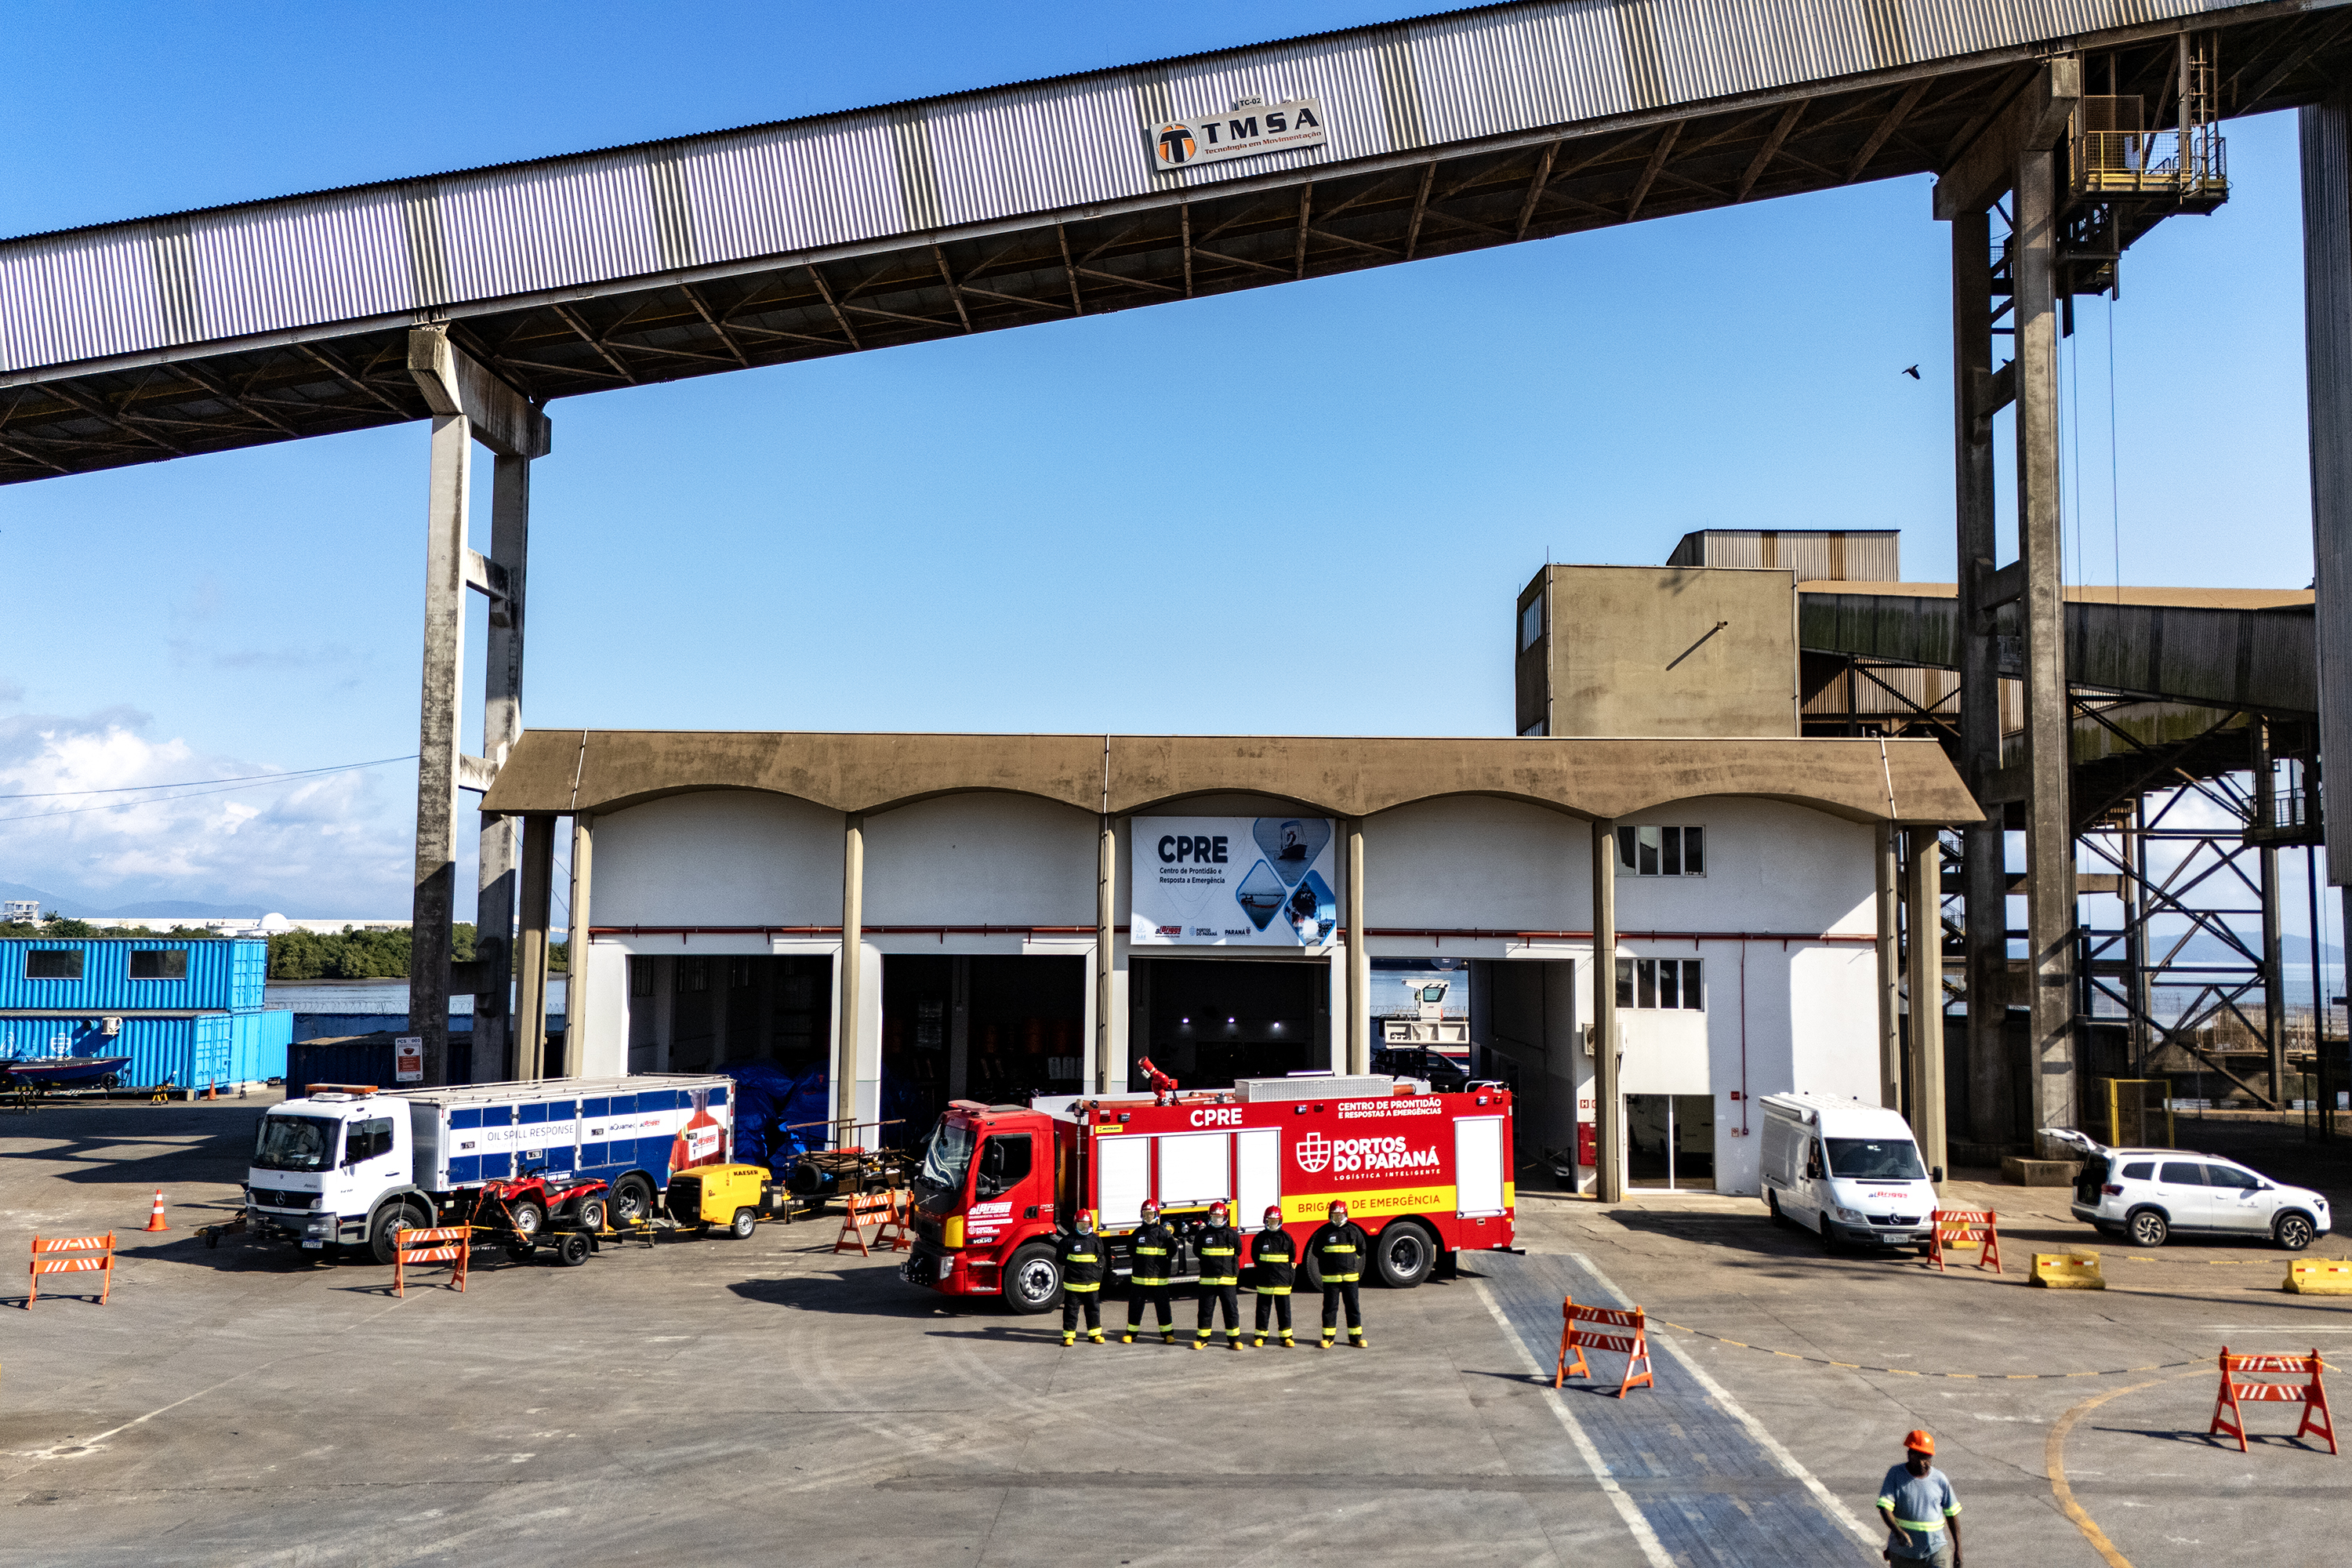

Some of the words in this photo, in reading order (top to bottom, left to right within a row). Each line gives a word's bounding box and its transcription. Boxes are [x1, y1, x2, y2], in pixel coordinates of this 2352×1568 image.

[1239, 97, 1261, 107] TC-02
[1201, 107, 1319, 144] TMSA
[1204, 143, 1247, 155] Tecnologia
[1262, 131, 1322, 146] Movimentação
[1158, 835, 1229, 863] CPRE
[1338, 1102, 1374, 1111] CENTRO
[1377, 1100, 1388, 1109] DE
[1390, 1097, 1442, 1109] PRONTIDÃO
[1345, 1109, 1385, 1119] RESPOSTAS
[1393, 1106, 1442, 1116] EMERGÊNCIAS
[1581, 1100, 1588, 1109] H
[1190, 1108, 1243, 1127] CPRE
[487, 1131, 501, 1141] OIL
[503, 1129, 528, 1140] SPILL
[530, 1124, 574, 1137] RESPONSE
[1334, 1136, 1406, 1156] PORTOS
[1334, 1155, 1362, 1172] DO
[1365, 1145, 1440, 1170] PARANÁ
[1334, 1172, 1381, 1181] LOGÍSTICA
[1385, 1168, 1440, 1178] INTELIGENTE
[1298, 1202, 1331, 1213] BRIGA
[1352, 1200, 1367, 1209] DE
[1370, 1194, 1440, 1208] EMERGÊNCIA
